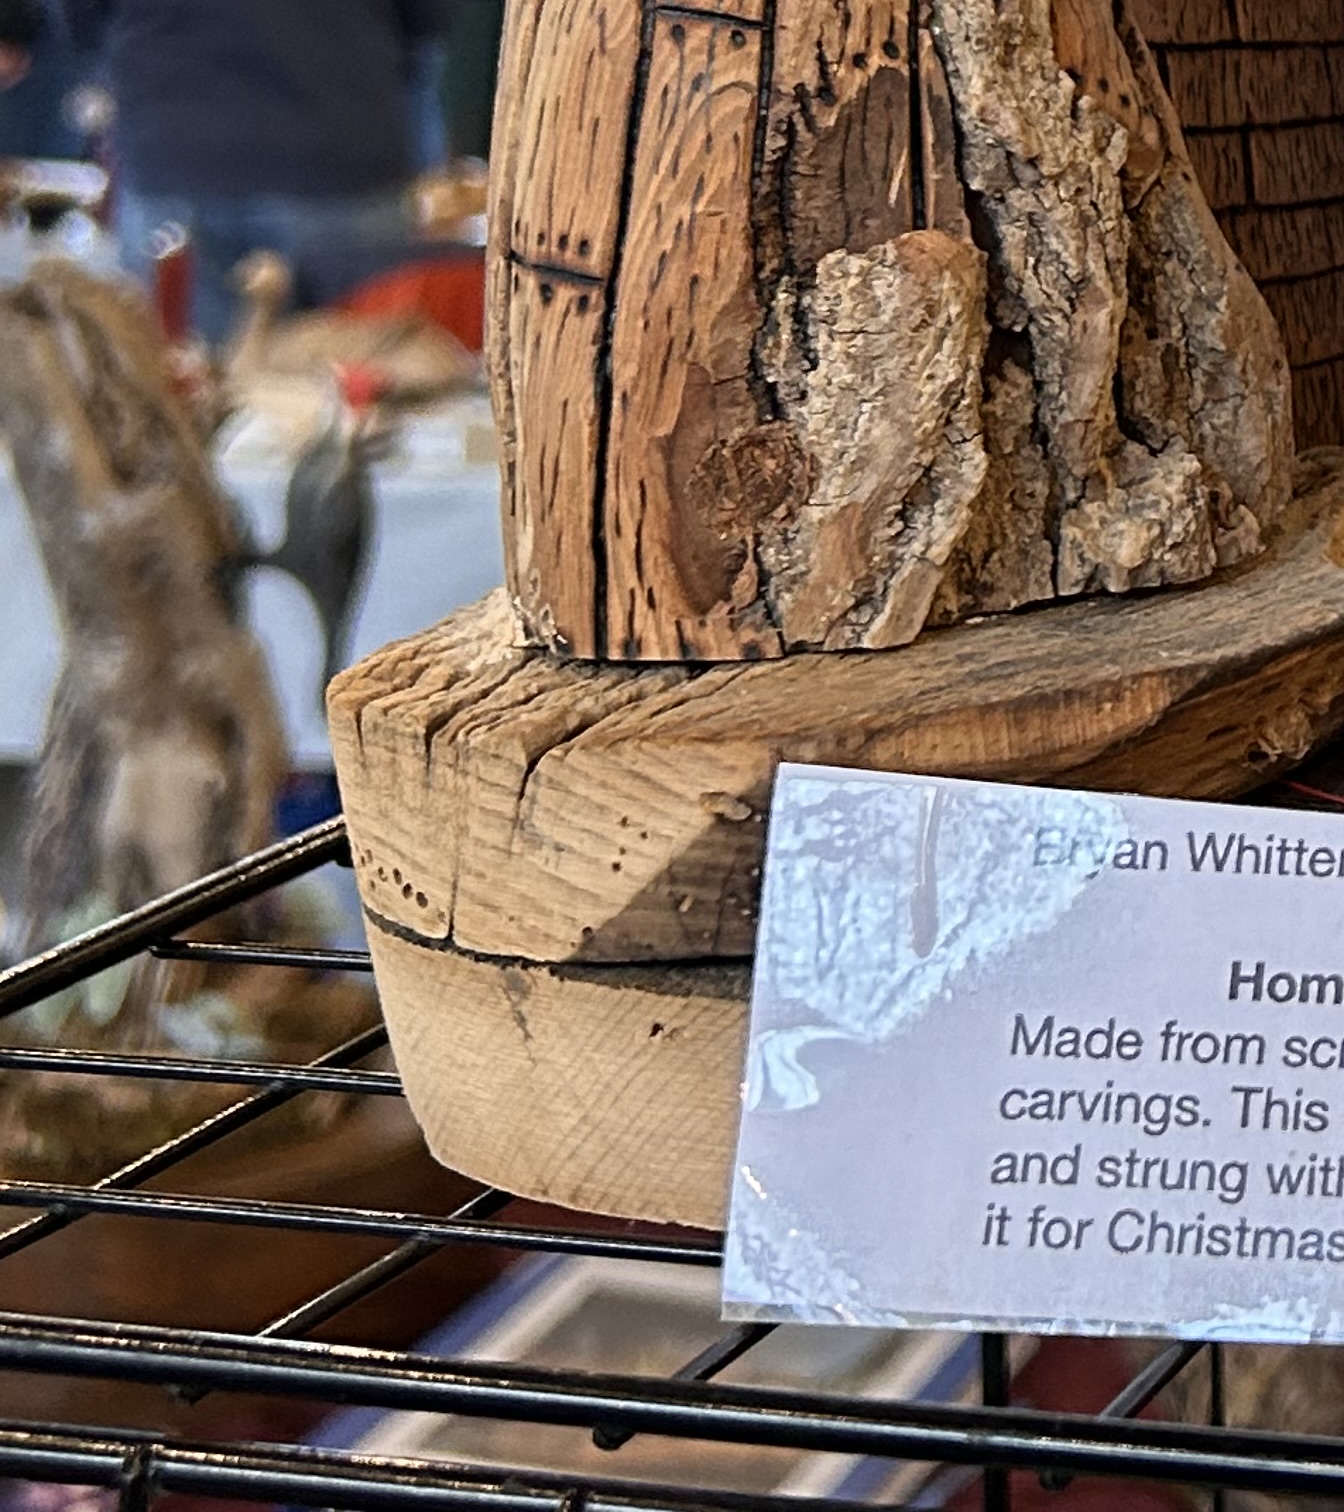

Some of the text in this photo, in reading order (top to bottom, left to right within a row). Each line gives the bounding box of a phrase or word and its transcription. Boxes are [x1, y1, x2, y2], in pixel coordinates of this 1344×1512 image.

[1010, 1013, 1145, 1062] Made
[1159, 1019, 1266, 1066] from
[999, 1079, 1212, 1137] carvings.
[1230, 1085, 1330, 1134] This
[990, 1143, 1082, 1187] and
[1095, 1148, 1249, 1206] strung
[981, 1202, 1013, 1247] it
[1027, 1204, 1095, 1251] for
